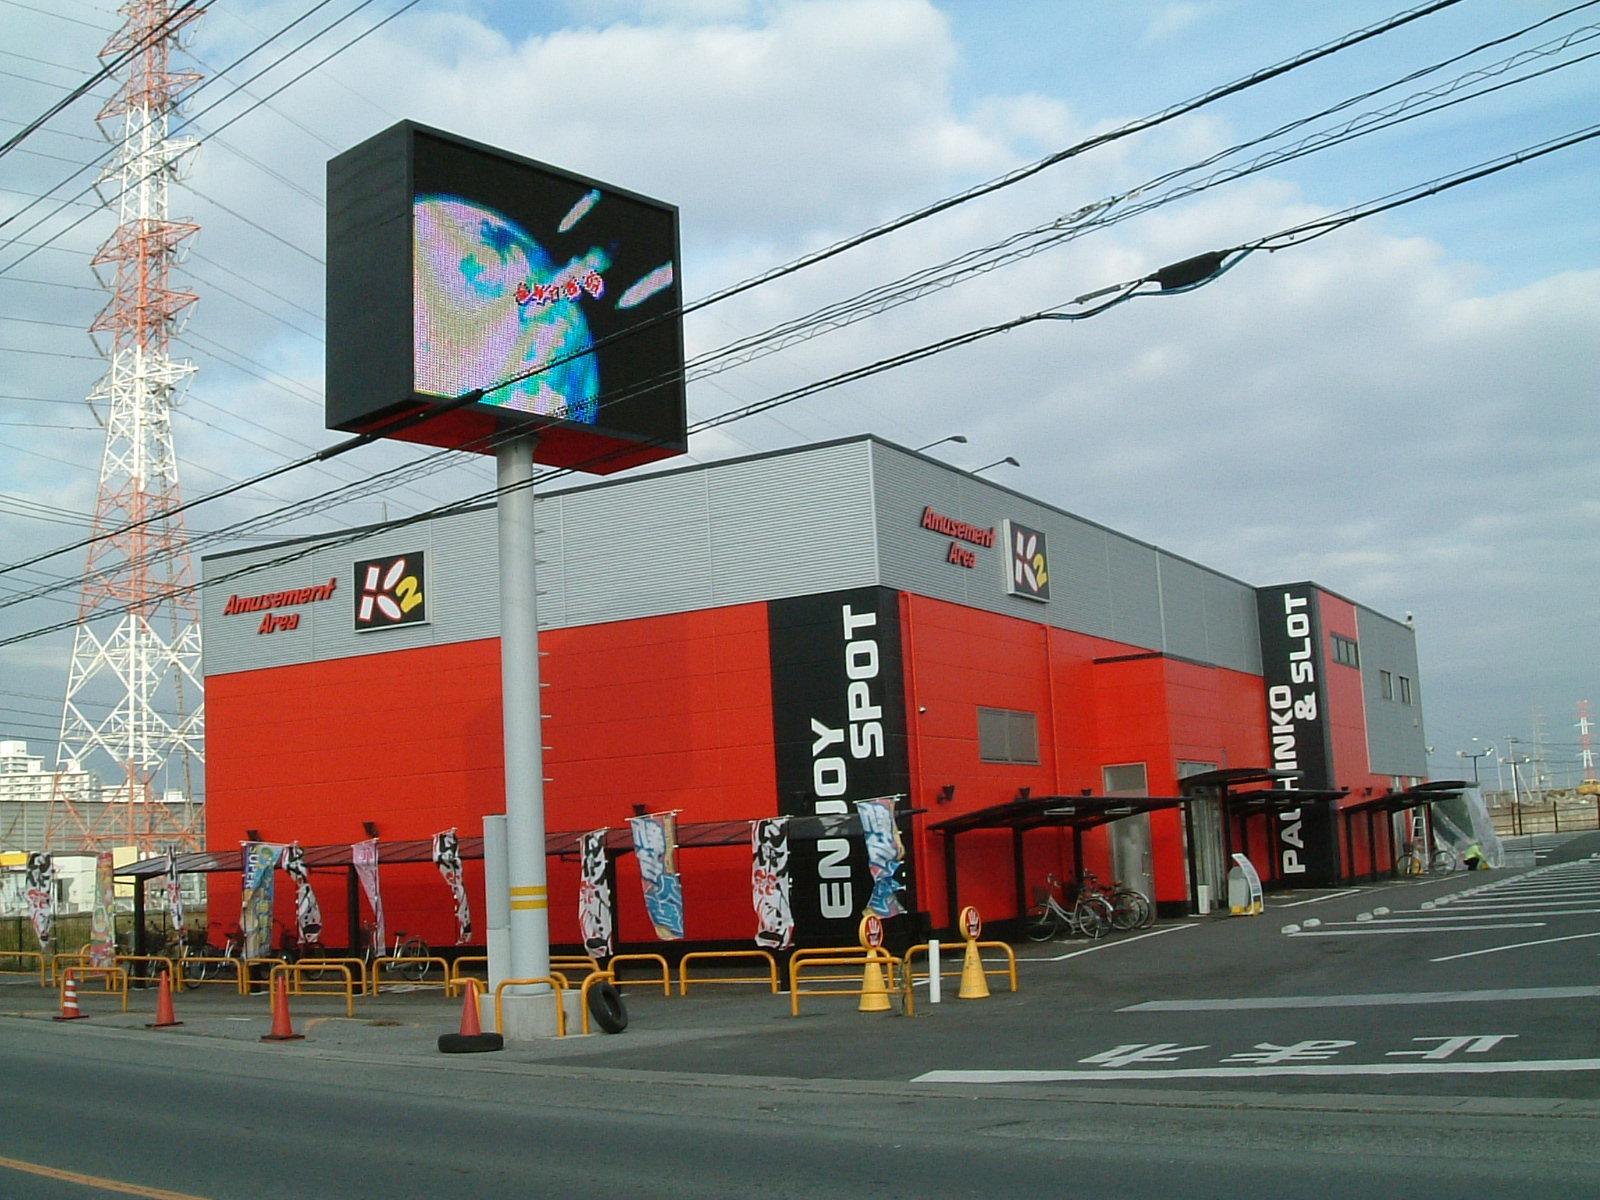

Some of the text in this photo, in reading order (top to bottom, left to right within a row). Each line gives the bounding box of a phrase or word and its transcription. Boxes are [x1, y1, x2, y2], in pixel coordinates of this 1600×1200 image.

[921, 505, 996, 548] Amusement
[948, 543, 977, 569] Area
[224, 578, 337, 615] Amusement
[258, 612, 300, 634] Area
[1284, 593, 1317, 720] & SLOT
[842, 605, 884, 758] SPOT
